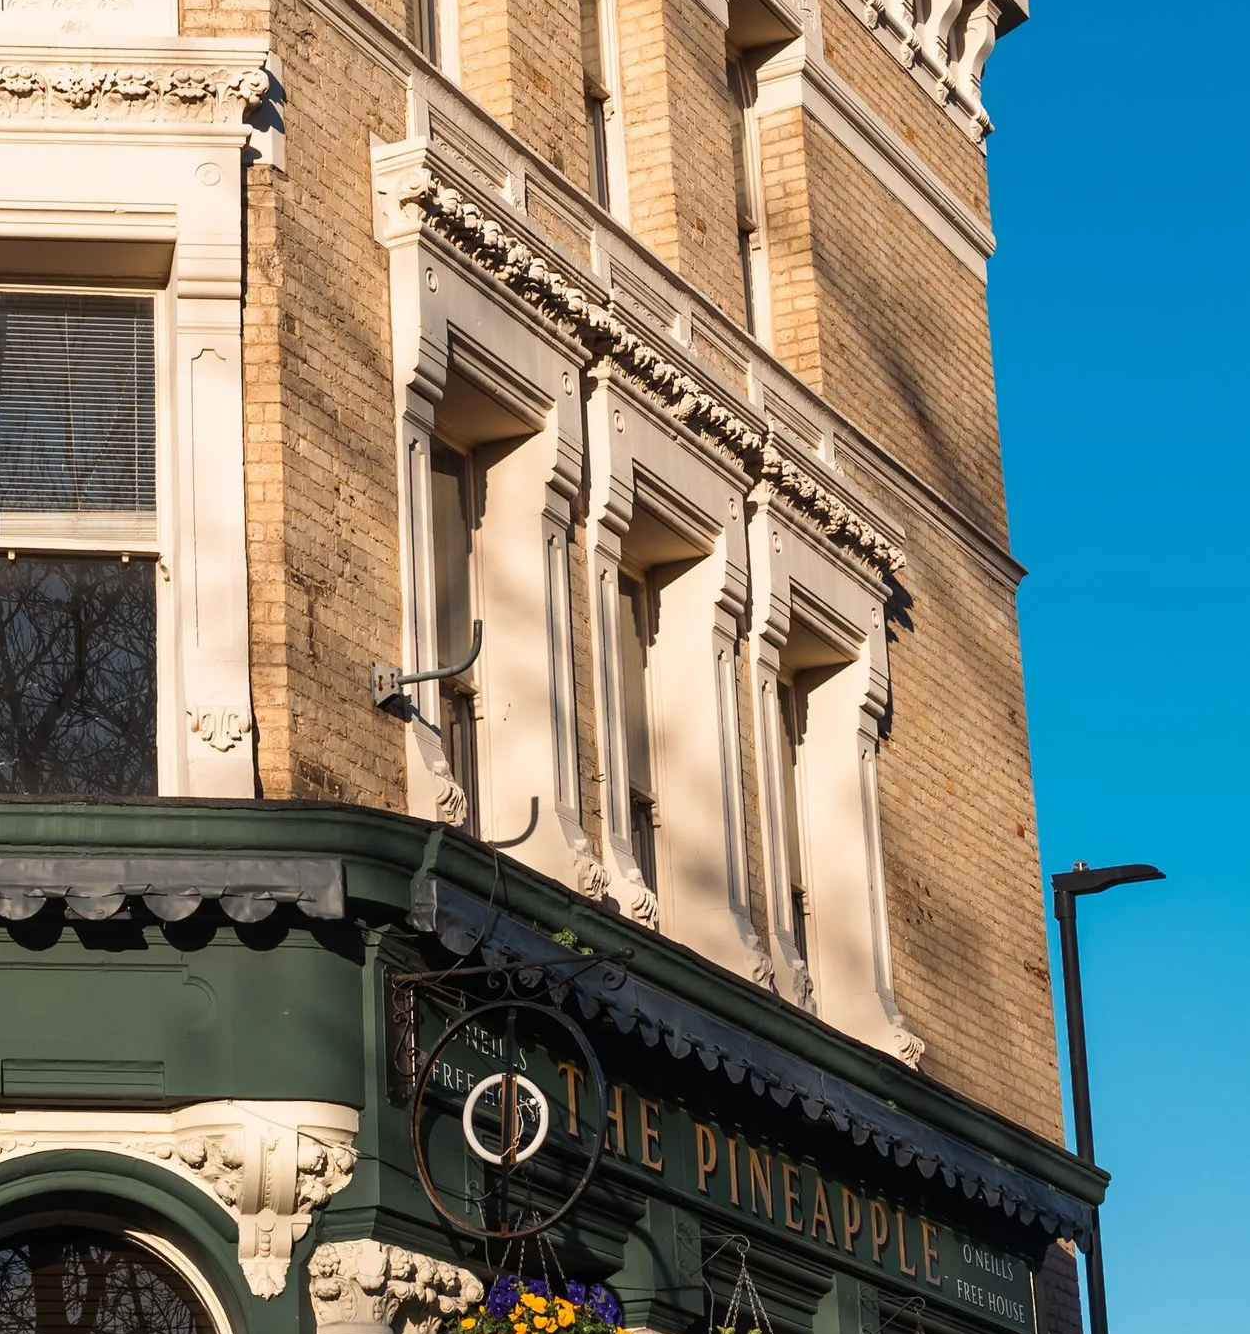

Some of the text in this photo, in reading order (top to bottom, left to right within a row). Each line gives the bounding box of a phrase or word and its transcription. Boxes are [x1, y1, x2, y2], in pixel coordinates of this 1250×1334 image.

[445, 1018, 527, 1071] NEILS
[558, 1062, 942, 1287] THE PINEAPPLE
[963, 1243, 1013, 1281] O'NEILLS
[957, 1278, 1025, 1323] FREE HOUSE
